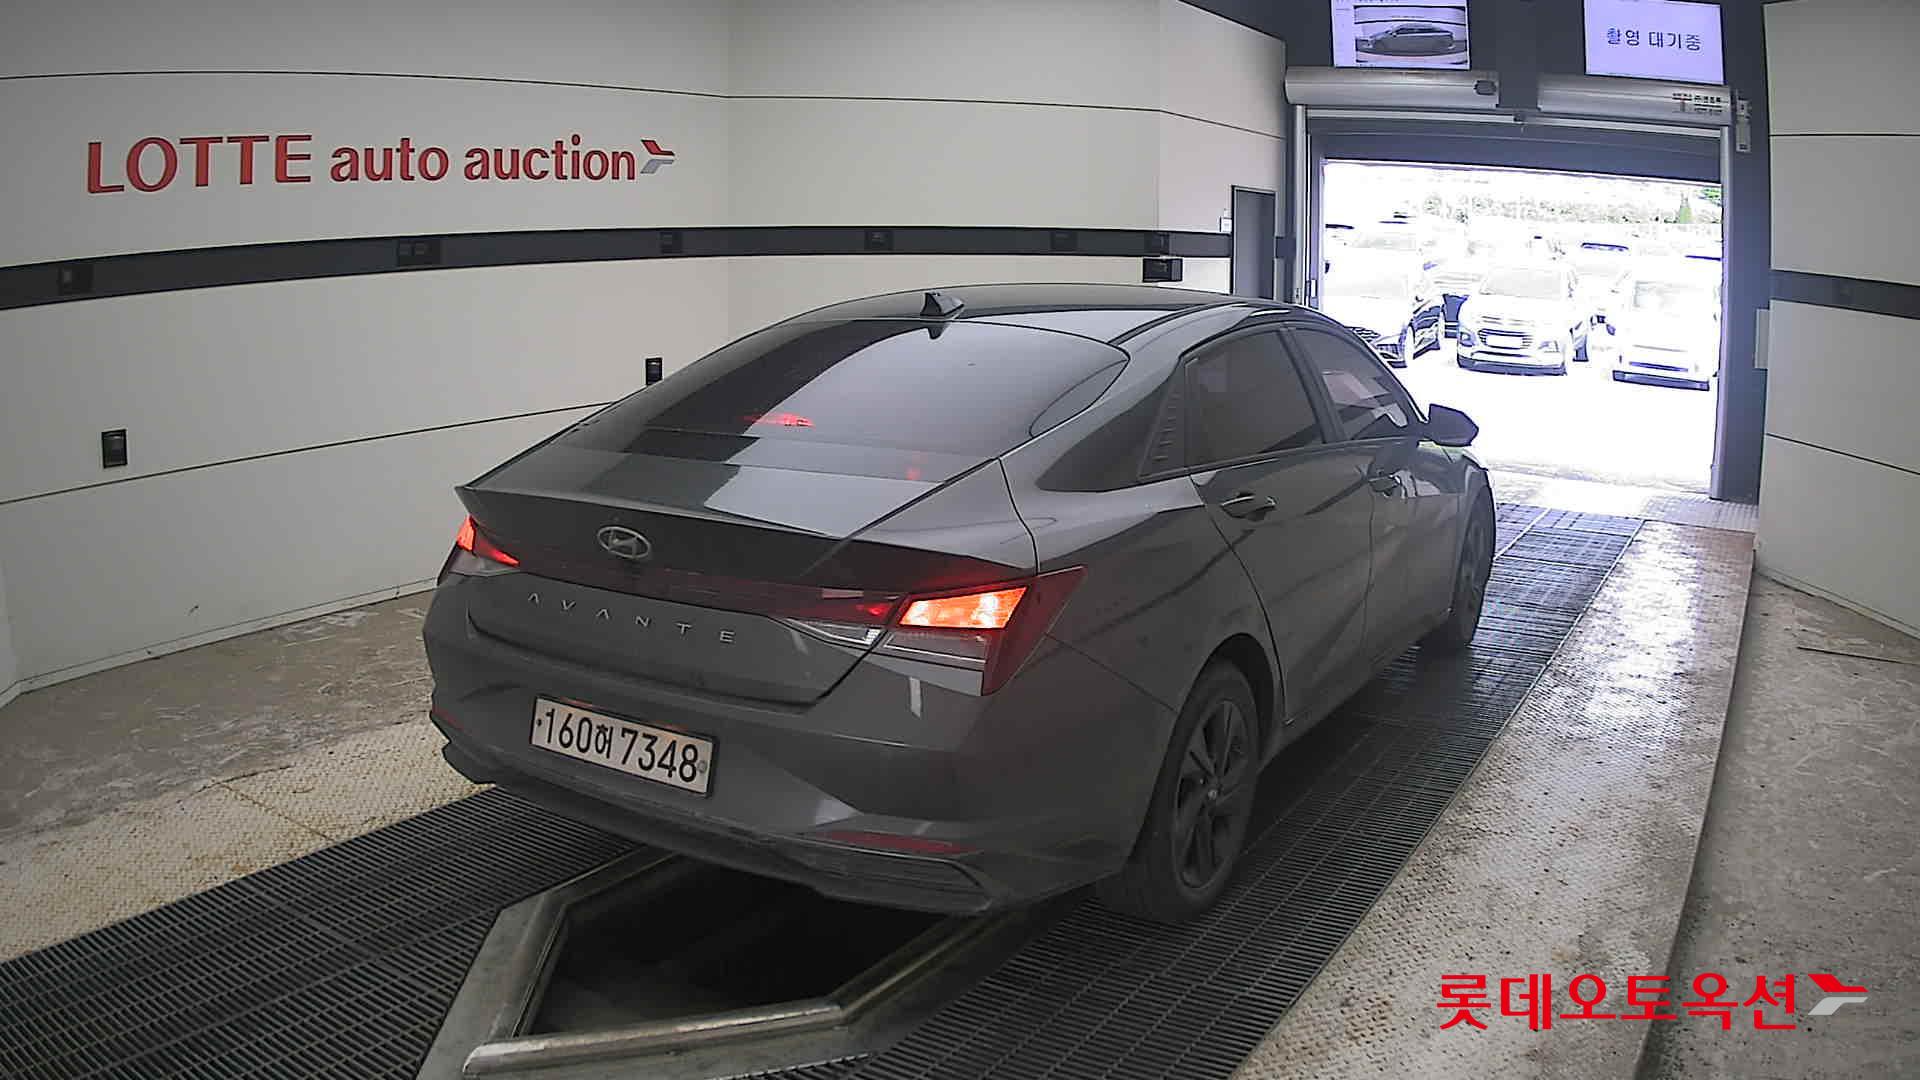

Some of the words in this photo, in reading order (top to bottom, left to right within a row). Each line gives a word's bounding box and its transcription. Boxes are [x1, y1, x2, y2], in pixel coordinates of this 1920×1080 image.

[1607, 27, 1640, 47] 촬영
[1648, 31, 1701, 51] 대기중
[88, 135, 312, 193] LOTTE
[330, 138, 450, 182] auto
[464, 134, 636, 181] auction
[528, 592, 735, 643] AVANTE
